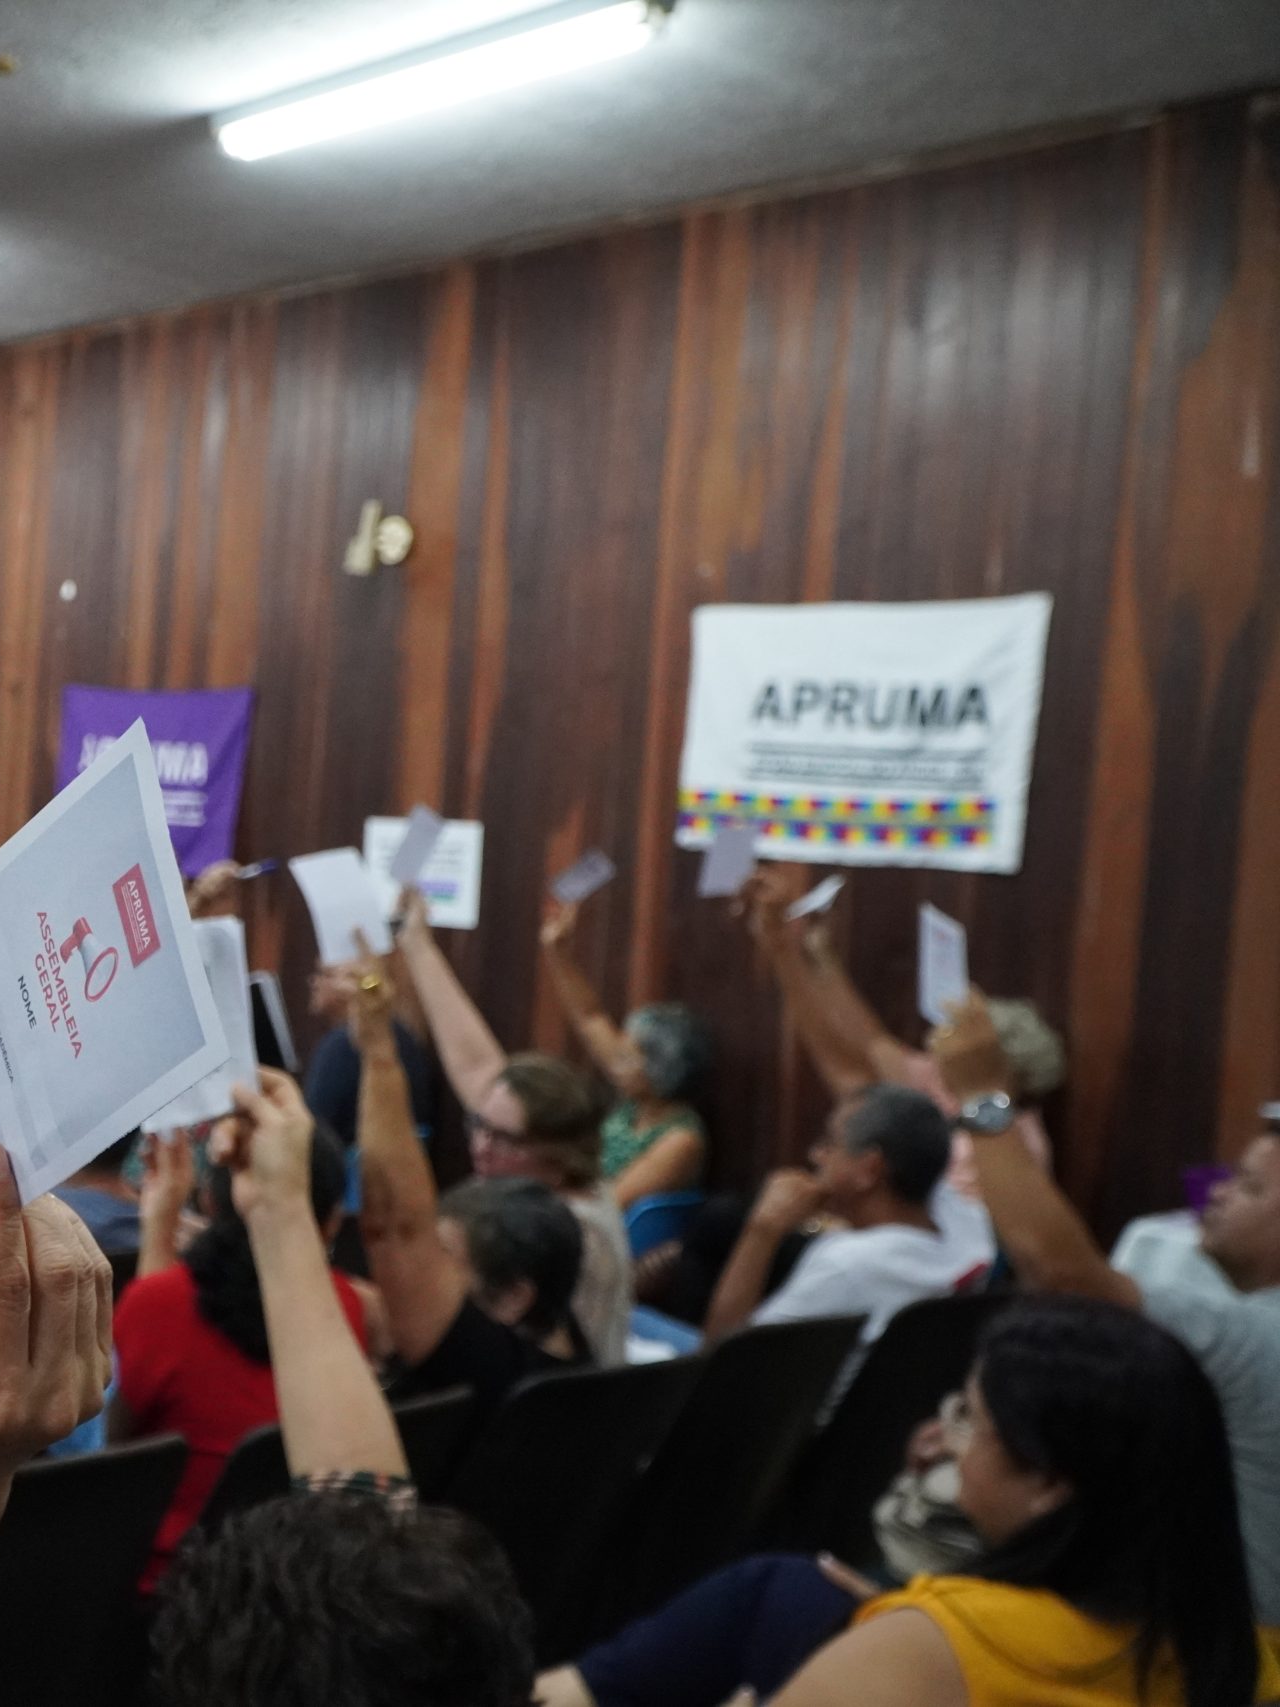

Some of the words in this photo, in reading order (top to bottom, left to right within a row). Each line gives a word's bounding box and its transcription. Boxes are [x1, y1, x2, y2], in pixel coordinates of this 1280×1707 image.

[751, 678, 989, 731] APRUMA
[128, 880, 151, 948] APRUMA
[18, 975, 37, 1030] NOME
[35, 954, 60, 1033] GERAL
[37, 912, 82, 1059] ASSEMBLEIA
